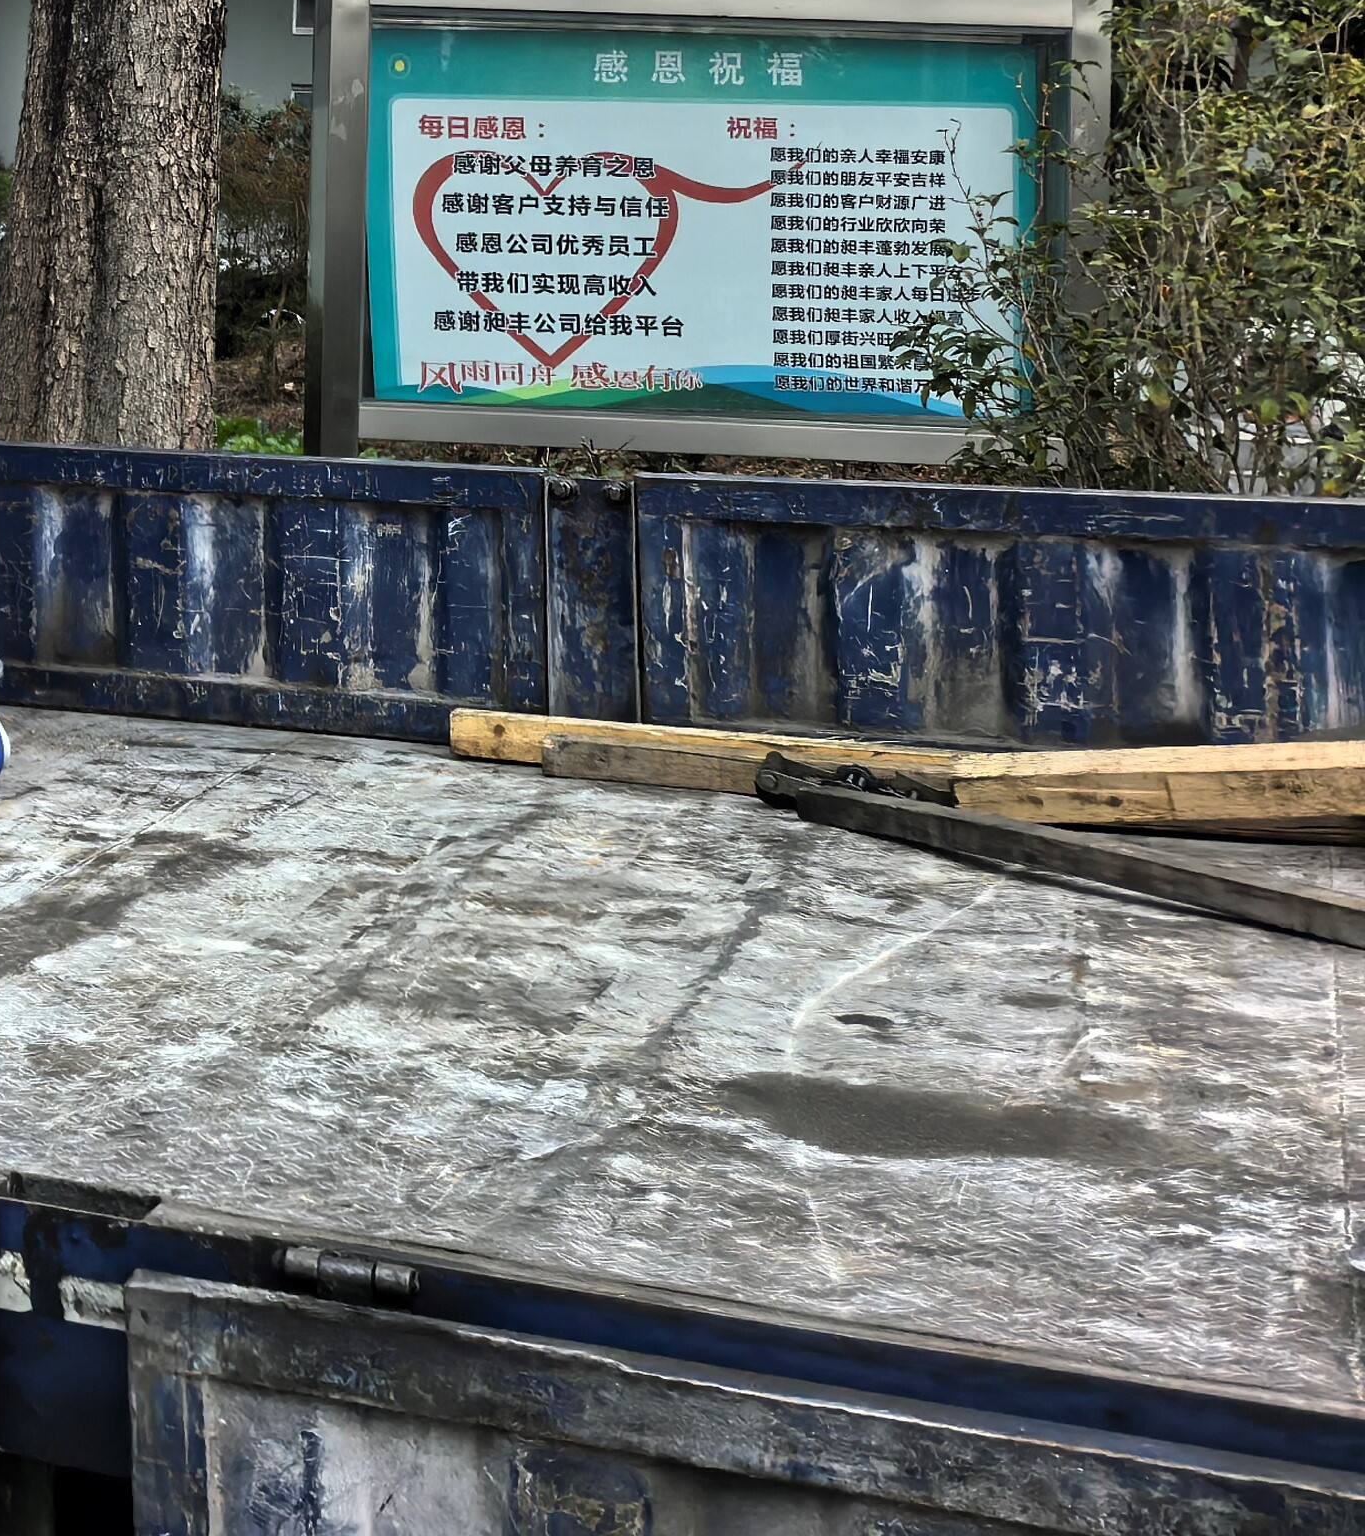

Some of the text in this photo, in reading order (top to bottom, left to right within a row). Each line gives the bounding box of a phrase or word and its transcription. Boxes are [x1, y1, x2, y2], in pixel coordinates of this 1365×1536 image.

[593, 50, 803, 86] 感恩祝福
[453, 154, 655, 179] 感谢父母养育之恩
[770, 147, 946, 165] 愿我们的亲人幸福安康
[770, 170, 946, 188] 愿我们的朋友平安吉祥
[442, 193, 669, 219] 感谢客户支持与信任
[770, 193, 946, 211] 愿我们的客户财源广进
[770, 215, 946, 234] 愿我们的行业欣欣向荣
[455, 232, 657, 257] 感恩公司优秀员工
[456, 270, 657, 297] 带我们实现高收入
[433, 310, 685, 337] 感谢昶丰公司给我平台
[417, 360, 704, 394] 风雨同舟 感恩有你
